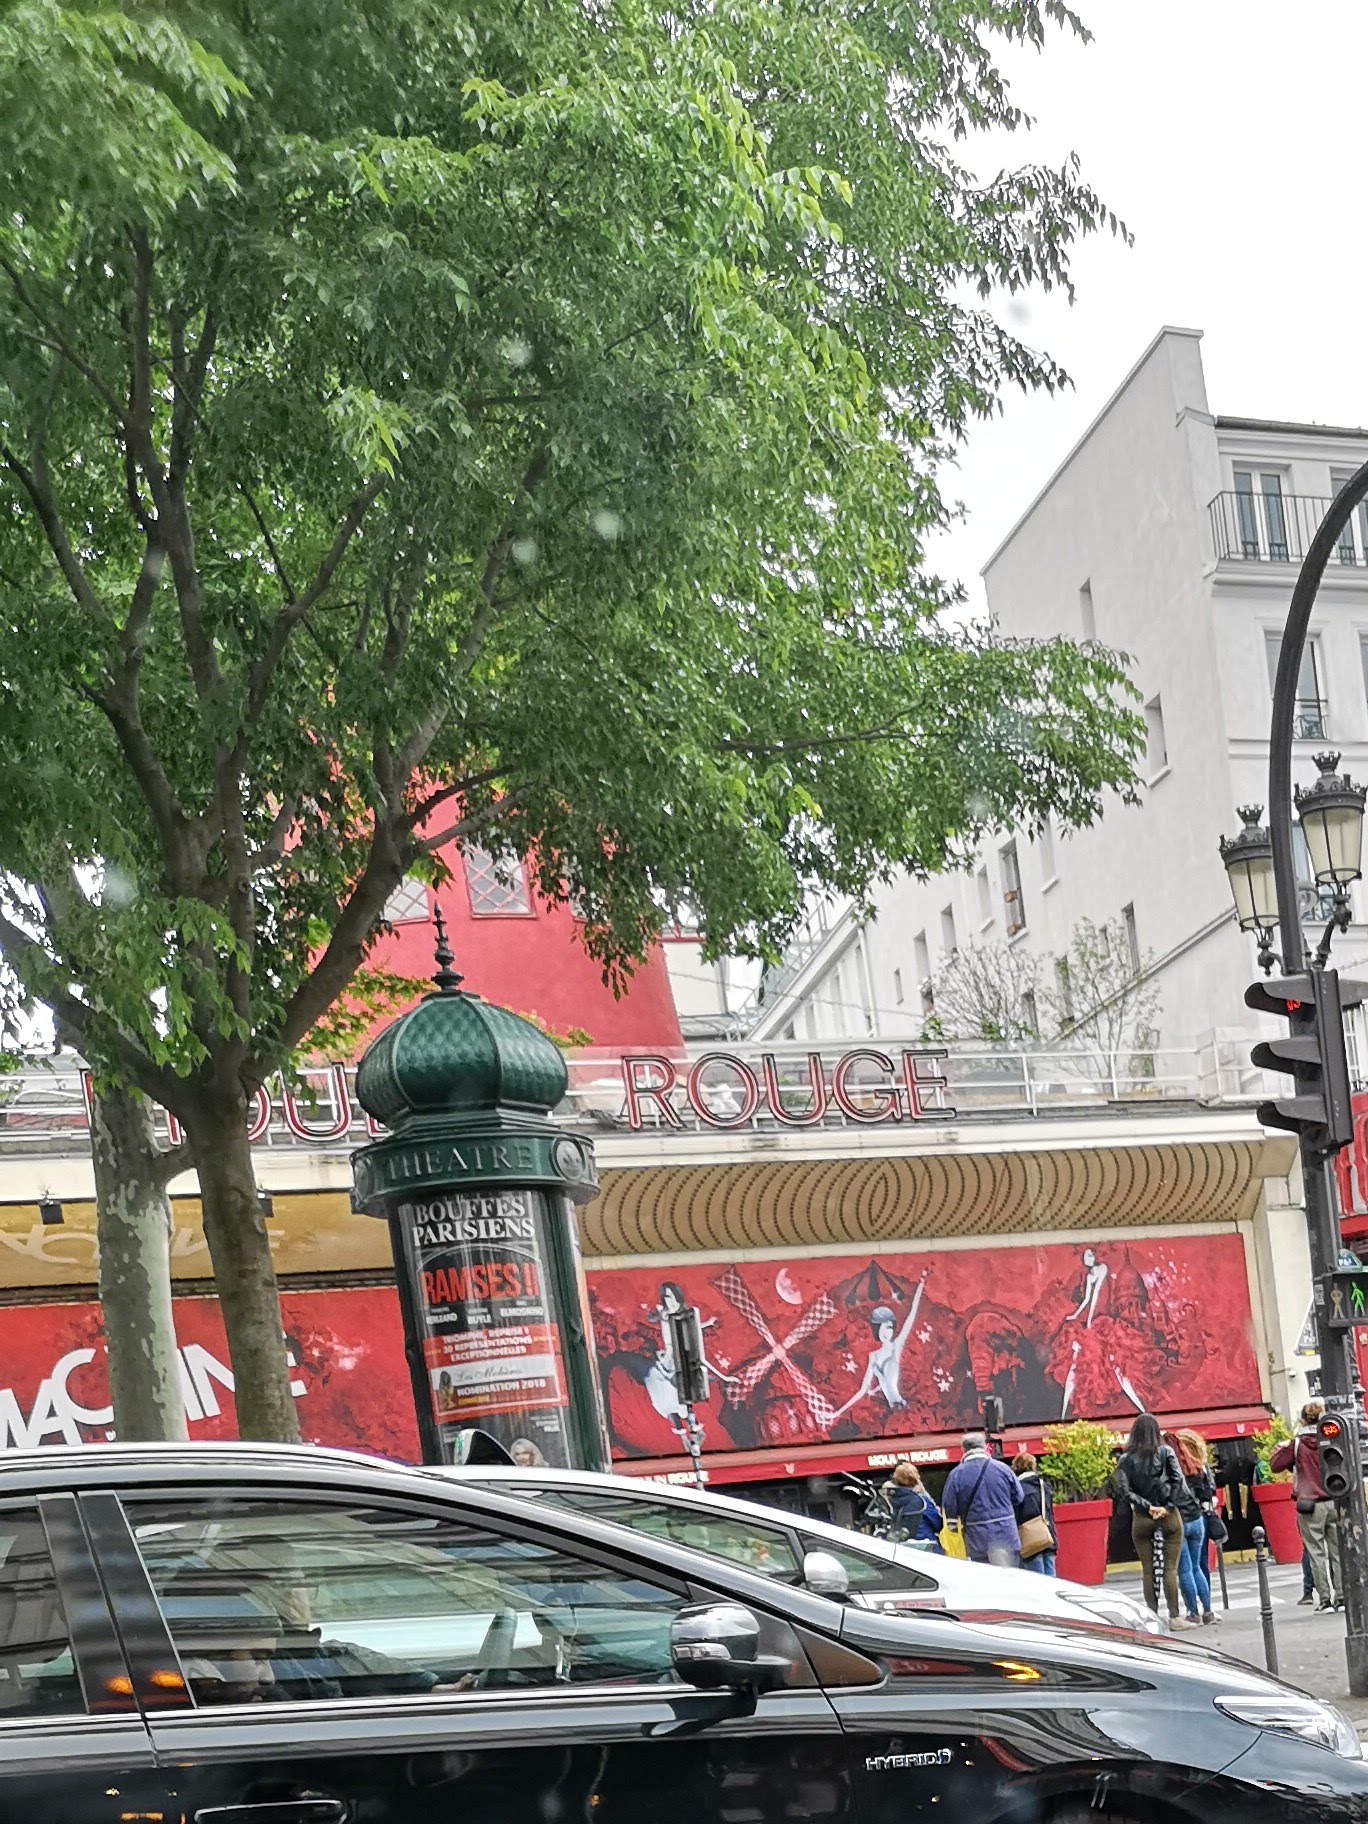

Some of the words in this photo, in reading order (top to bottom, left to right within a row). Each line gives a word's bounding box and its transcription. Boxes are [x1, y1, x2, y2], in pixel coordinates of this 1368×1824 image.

[620, 1047, 957, 1130] ROUGE
[387, 1143, 535, 1181] THEATRE
[414, 1195, 526, 1225] BOUFFES
[411, 1217, 536, 1247] PARISIENS
[456, 1380, 520, 1397] NOMINATION
[865, 1751, 939, 1771] HYBRID
